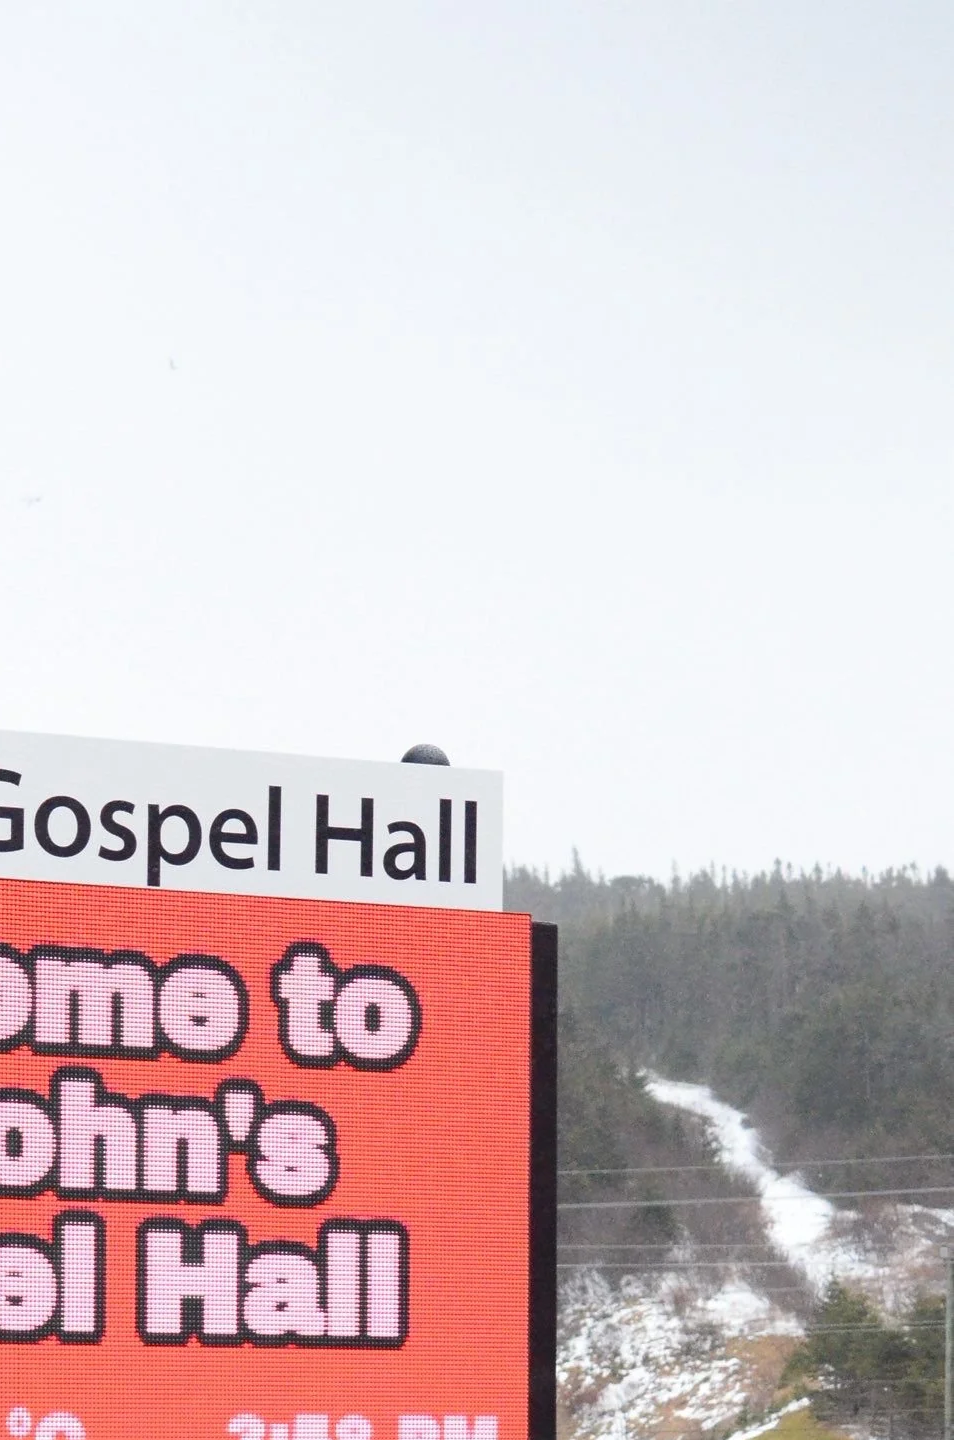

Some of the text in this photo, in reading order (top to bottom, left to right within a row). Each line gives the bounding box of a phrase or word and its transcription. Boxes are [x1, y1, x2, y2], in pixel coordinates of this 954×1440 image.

[316, 795, 478, 884] Hall
[272, 943, 421, 1070] to
[138, 1219, 409, 1347] Hall
